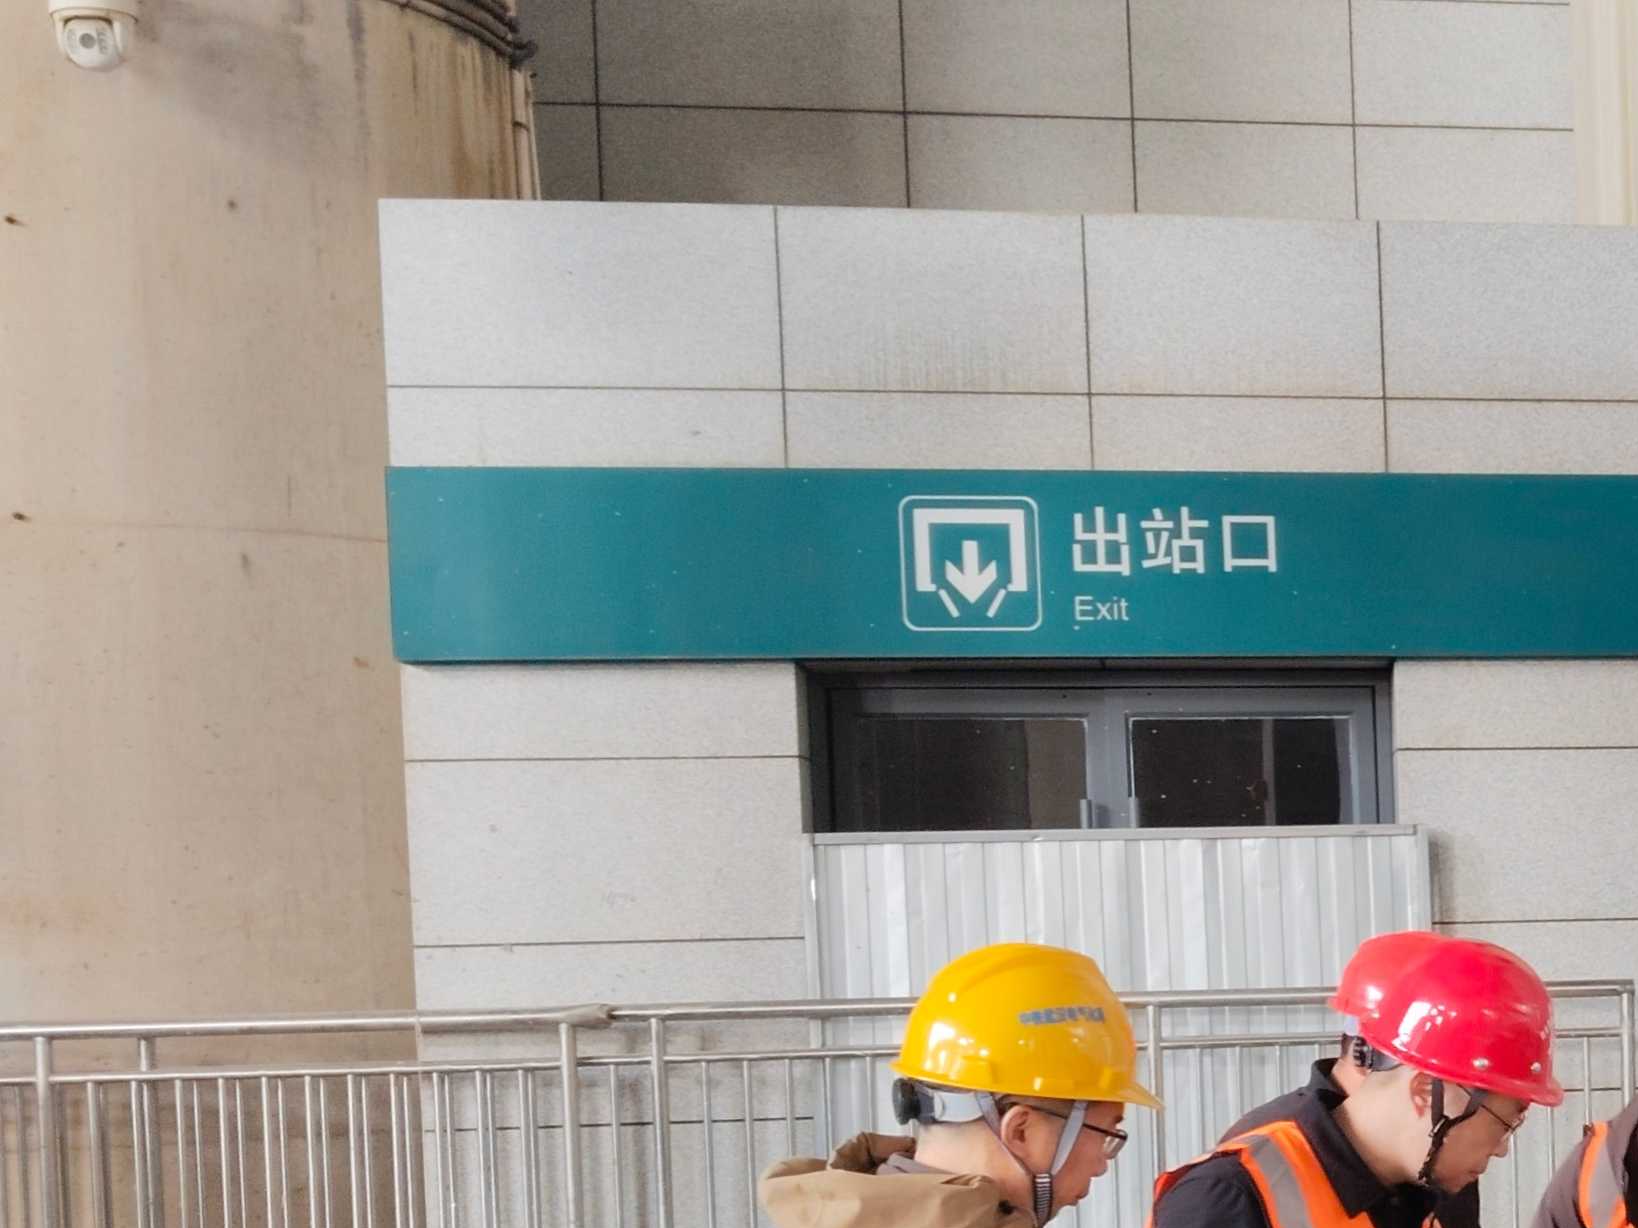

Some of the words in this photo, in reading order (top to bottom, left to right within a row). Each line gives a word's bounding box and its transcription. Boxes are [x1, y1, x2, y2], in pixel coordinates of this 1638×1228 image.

[1071, 505, 1278, 577] 出站口
[1074, 596, 1130, 622] Exit
